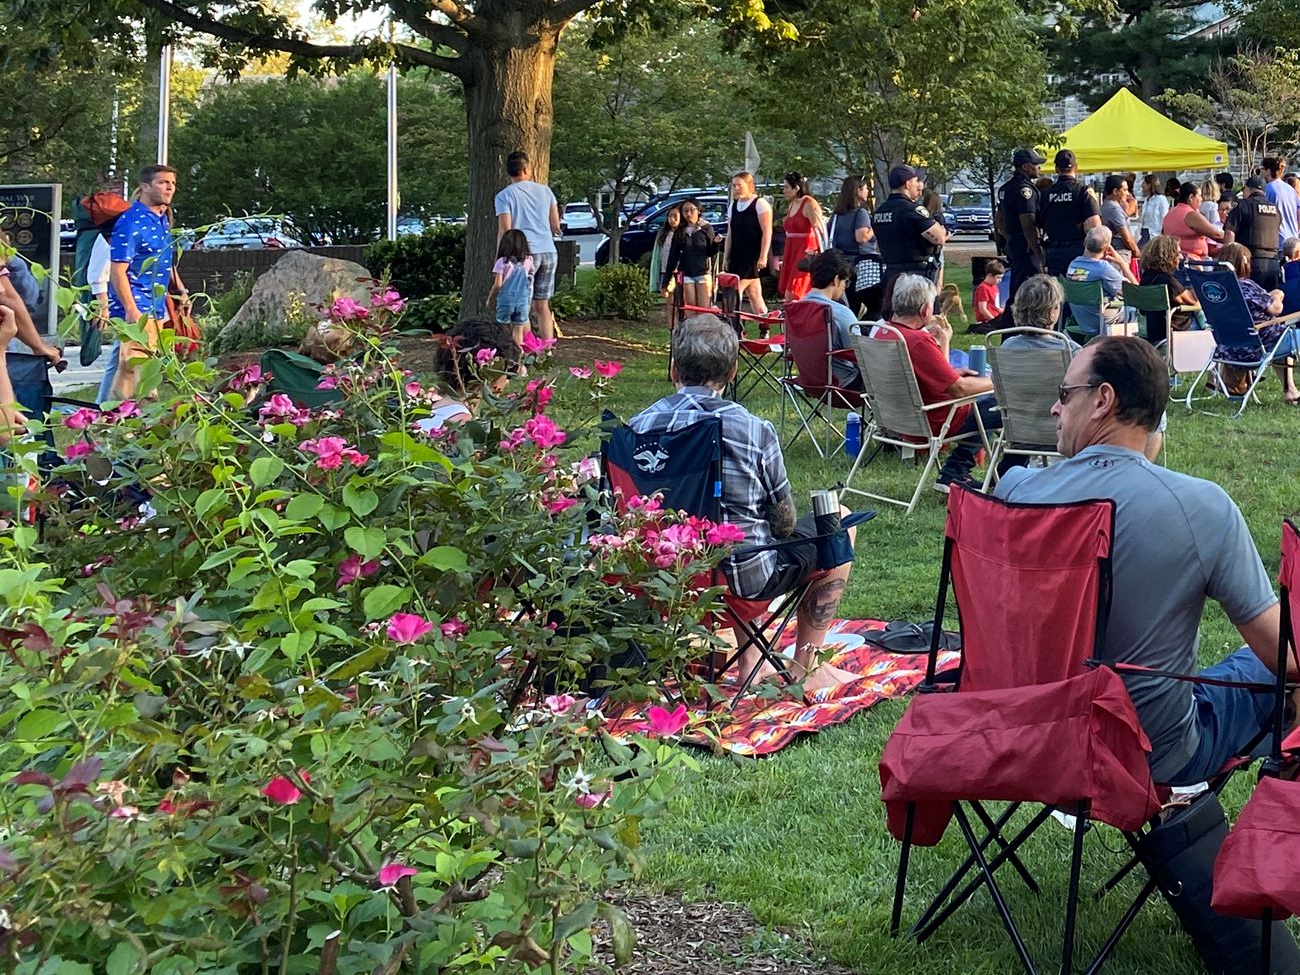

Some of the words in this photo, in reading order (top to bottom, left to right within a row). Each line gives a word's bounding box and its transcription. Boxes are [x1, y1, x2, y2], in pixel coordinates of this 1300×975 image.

[1049, 193, 1073, 202] POLICE
[1258, 205, 1277, 214] POLICE
[874, 212, 893, 223] POLICE
